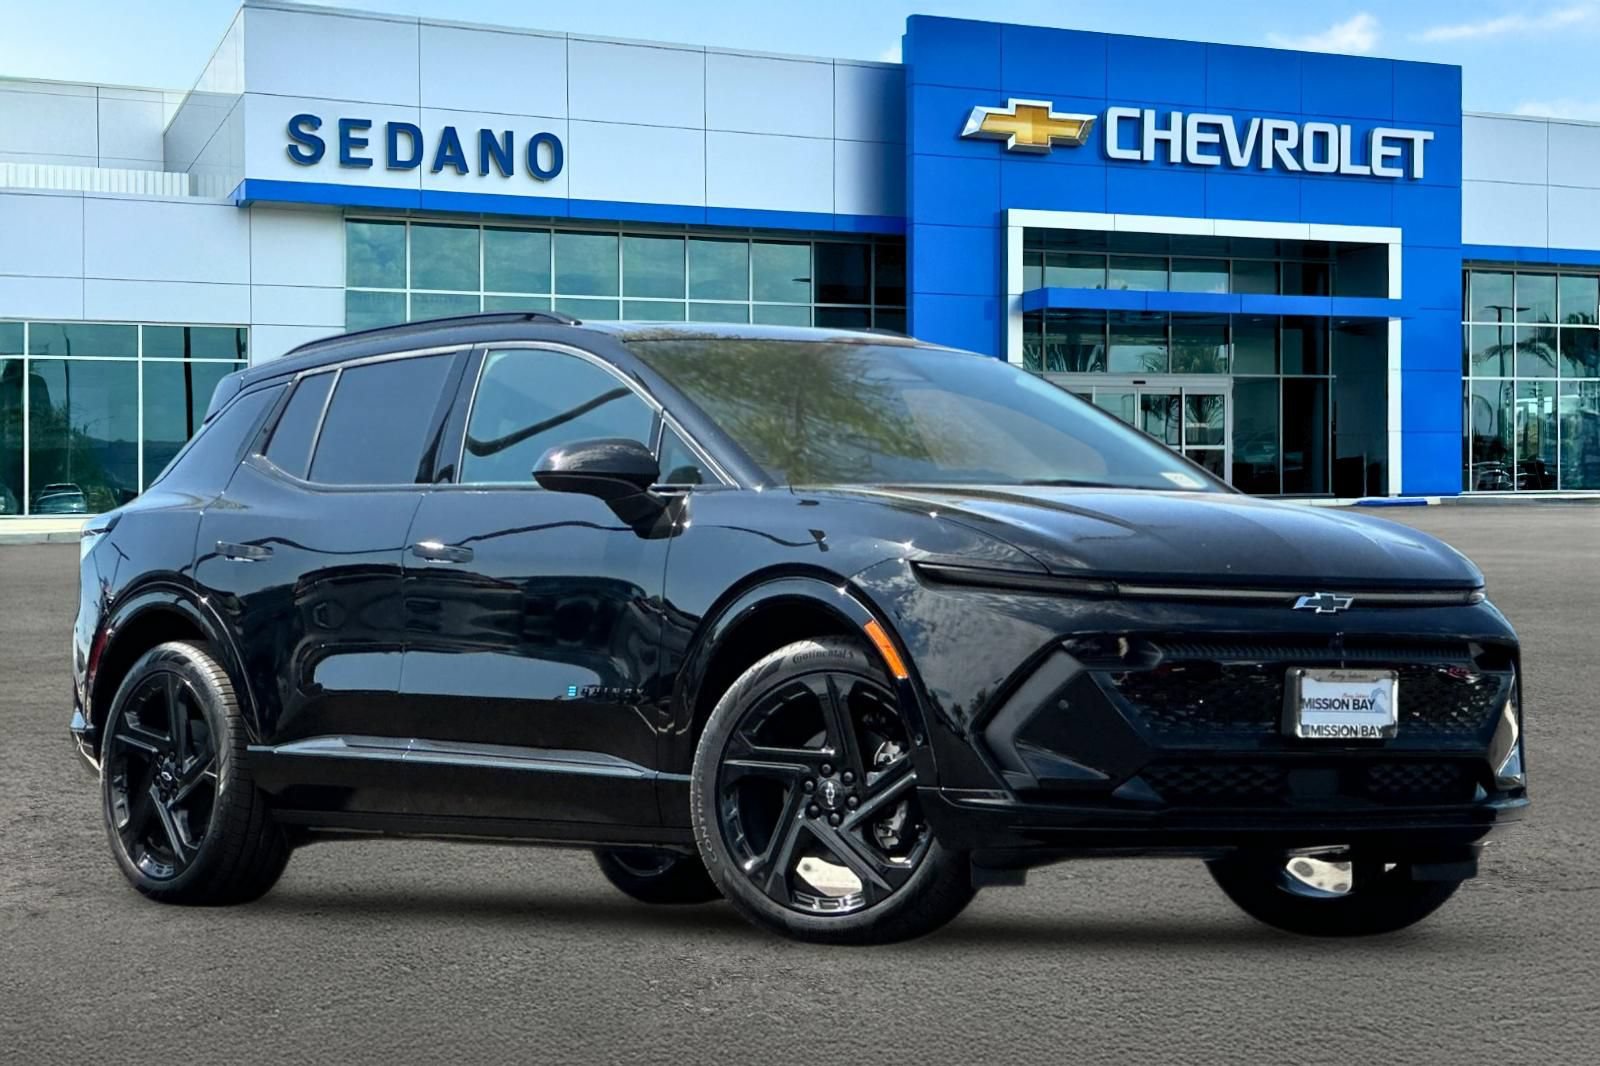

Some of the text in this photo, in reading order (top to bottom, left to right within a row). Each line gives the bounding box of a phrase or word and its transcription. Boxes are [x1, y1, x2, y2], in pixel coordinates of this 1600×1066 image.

[287, 114, 564, 181] SEDANO
[1105, 106, 1434, 179] CHEVROLET
[1302, 697, 1376, 711] MISSION BAY
[1311, 725, 1383, 737] MISSION BAY
